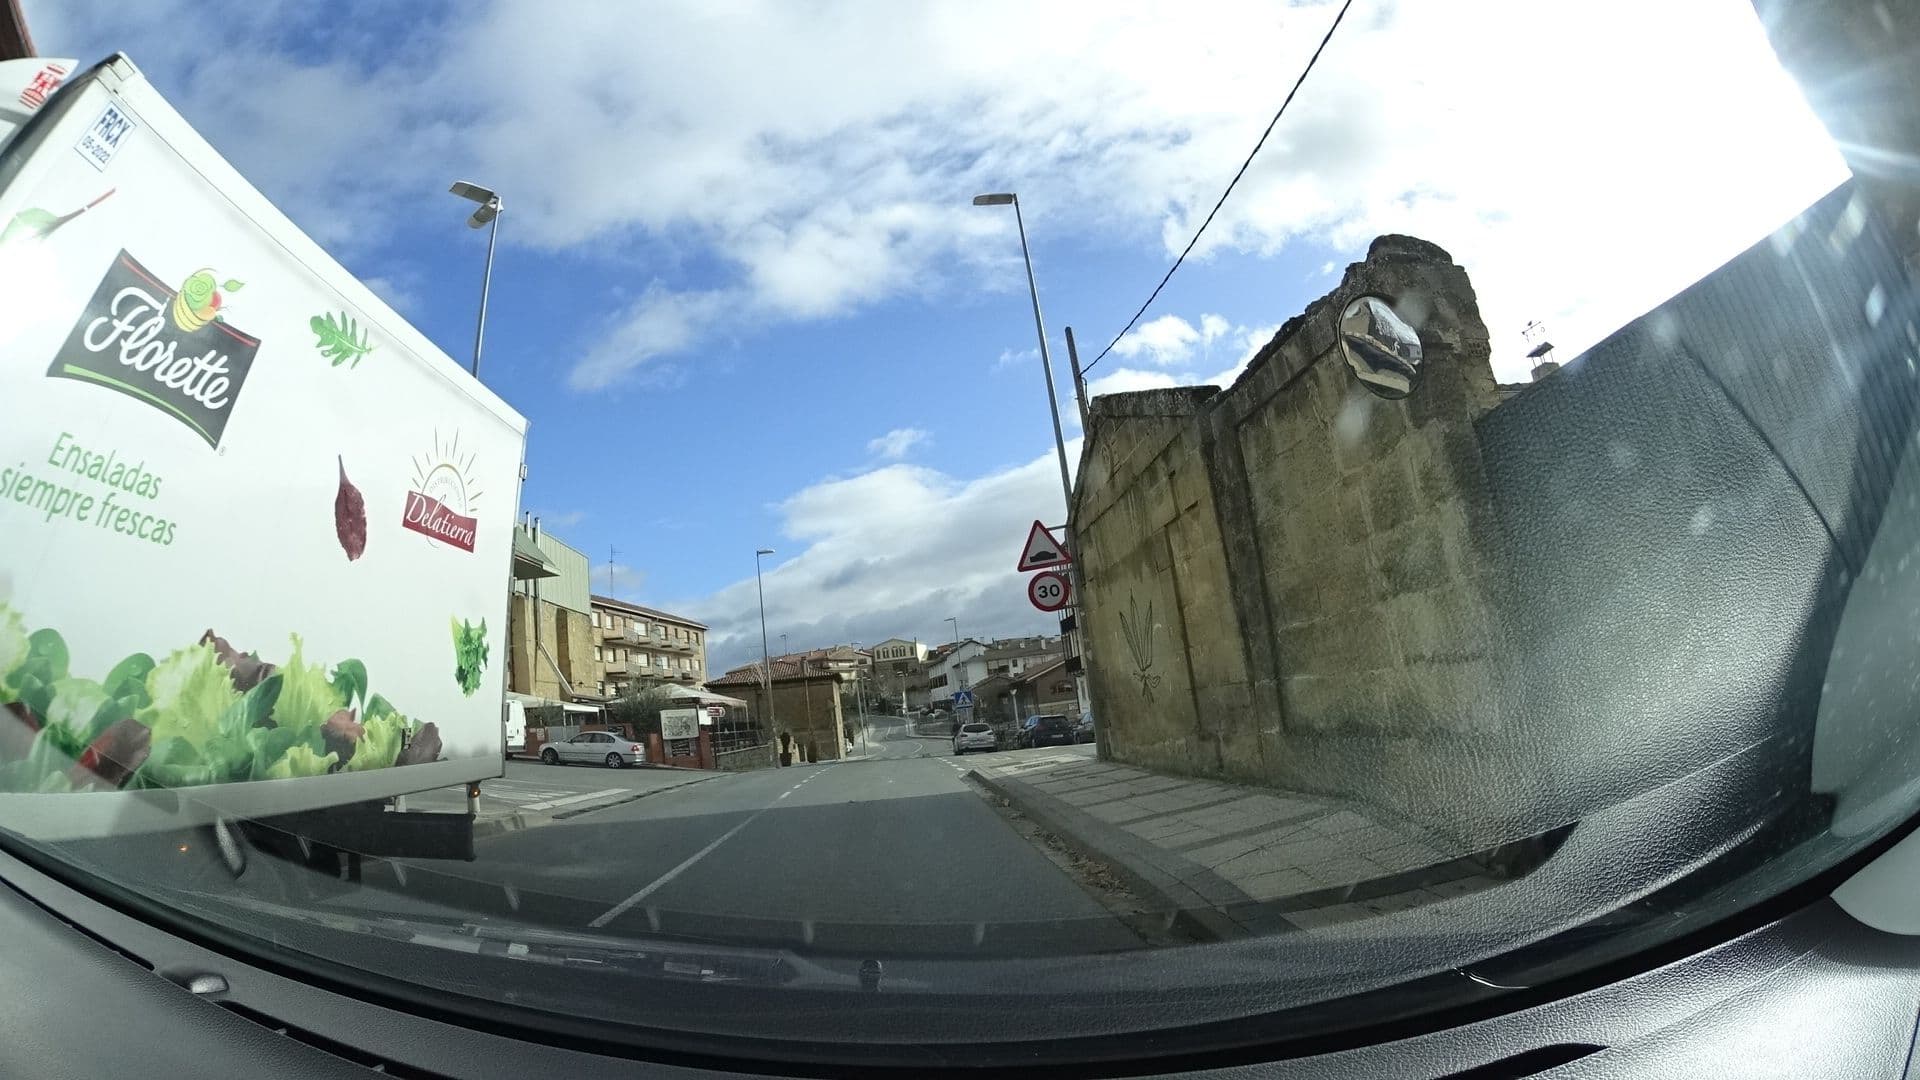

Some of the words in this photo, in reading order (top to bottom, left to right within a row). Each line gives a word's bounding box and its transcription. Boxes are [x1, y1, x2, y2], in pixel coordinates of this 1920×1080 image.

[94, 107, 130, 148] FRCX
[83, 286, 230, 409] Florette
[48, 431, 162, 500] Ensaladas
[0, 462, 94, 523] siempre
[95, 491, 177, 546] frescas
[405, 492, 474, 546] Delatierra
[1037, 584, 1060, 599] 30
